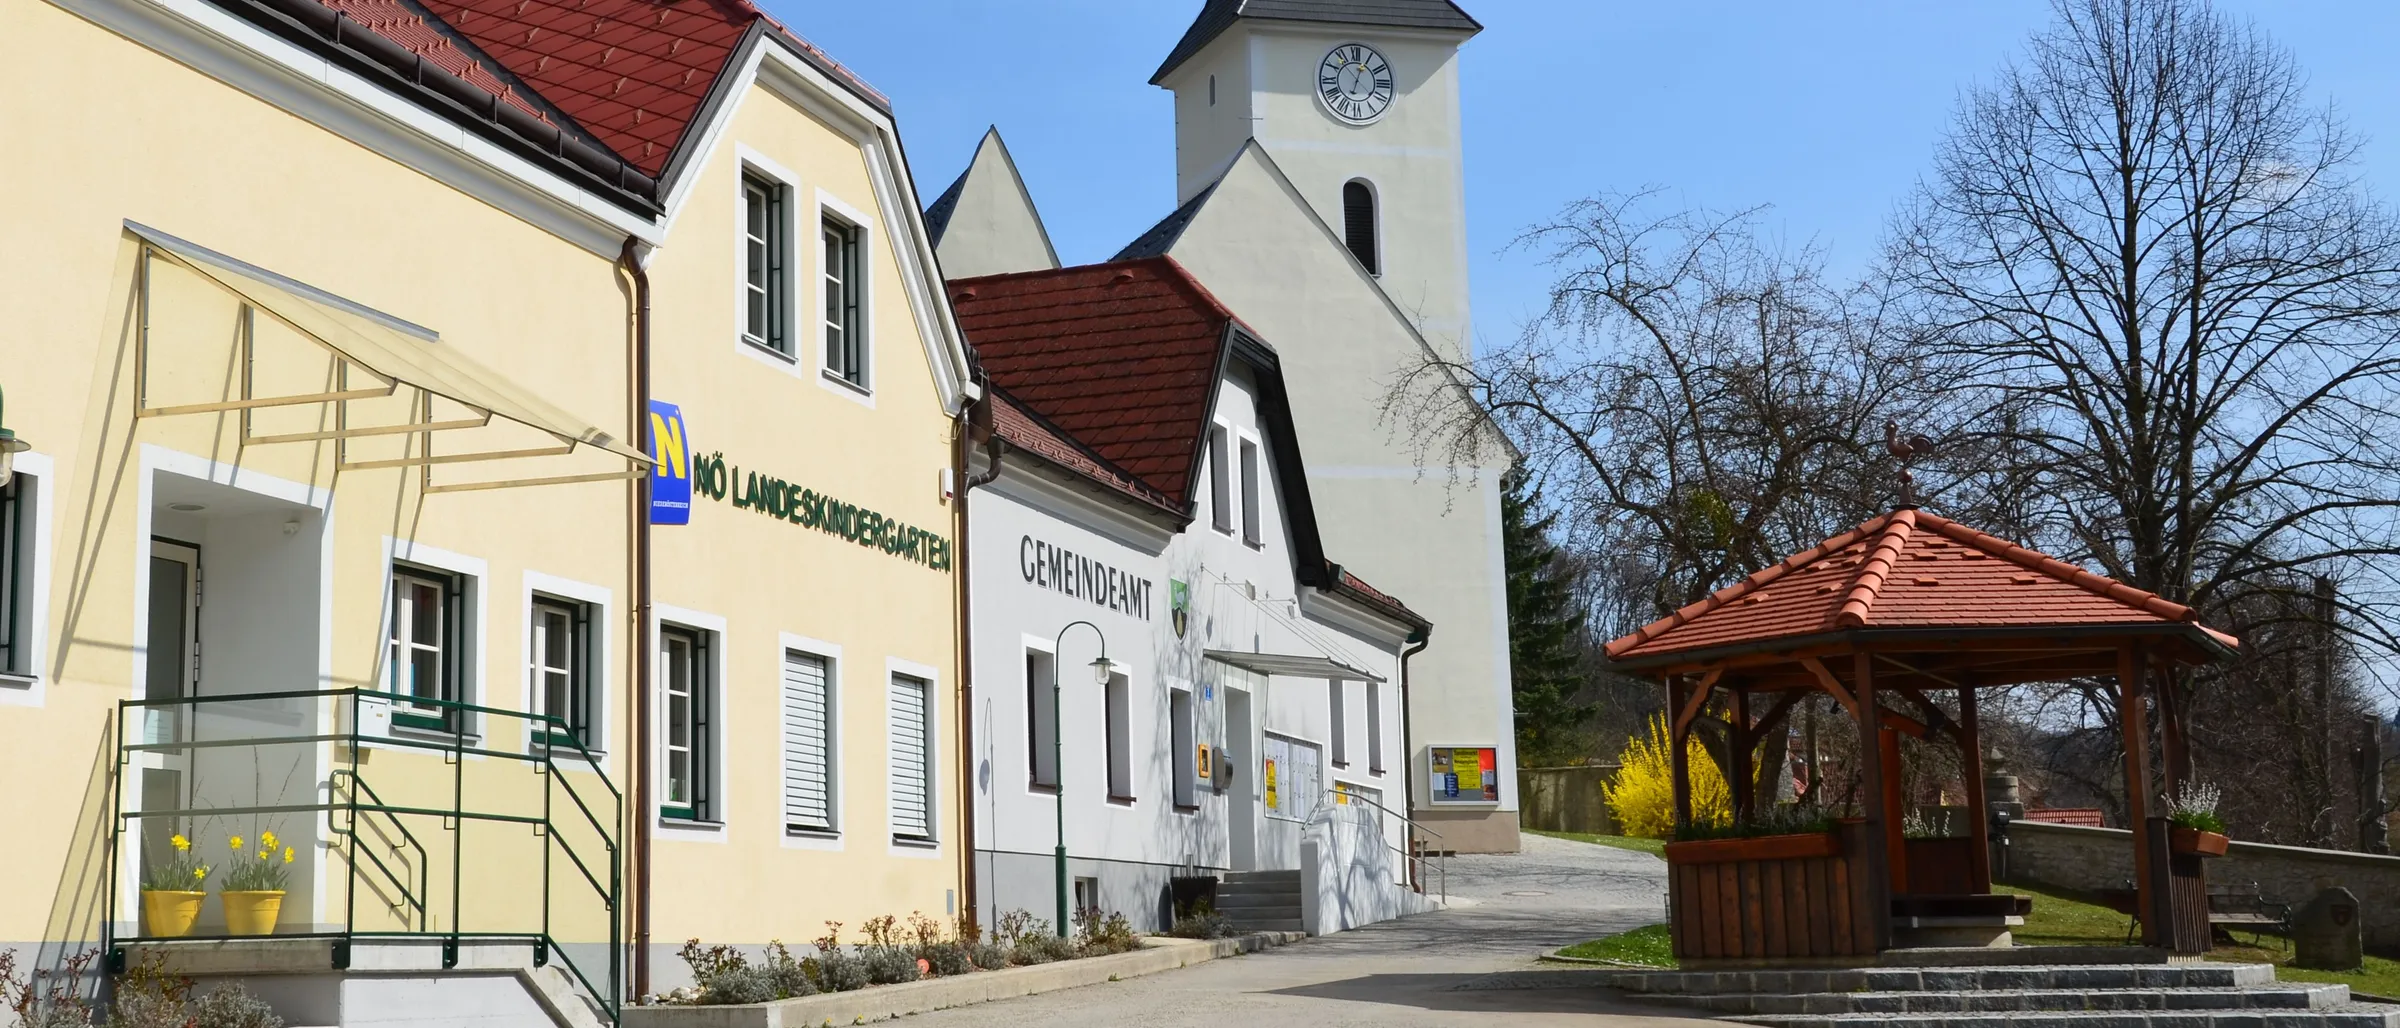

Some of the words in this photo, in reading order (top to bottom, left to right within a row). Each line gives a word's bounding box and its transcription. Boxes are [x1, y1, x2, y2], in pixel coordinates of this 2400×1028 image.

[1350, 46, 1361, 62] XII
[1372, 64, 1386, 75] II
[1322, 75, 1336, 85] IX
[1376, 79, 1390, 89] III
[1353, 102, 1362, 118] VI
[650, 412, 686, 479] N
[693, 450, 727, 502] NÖ
[732, 465, 951, 574] LANDESKINDERGARTEN
[1020, 534, 1152, 621] GEMEINDEAMT
